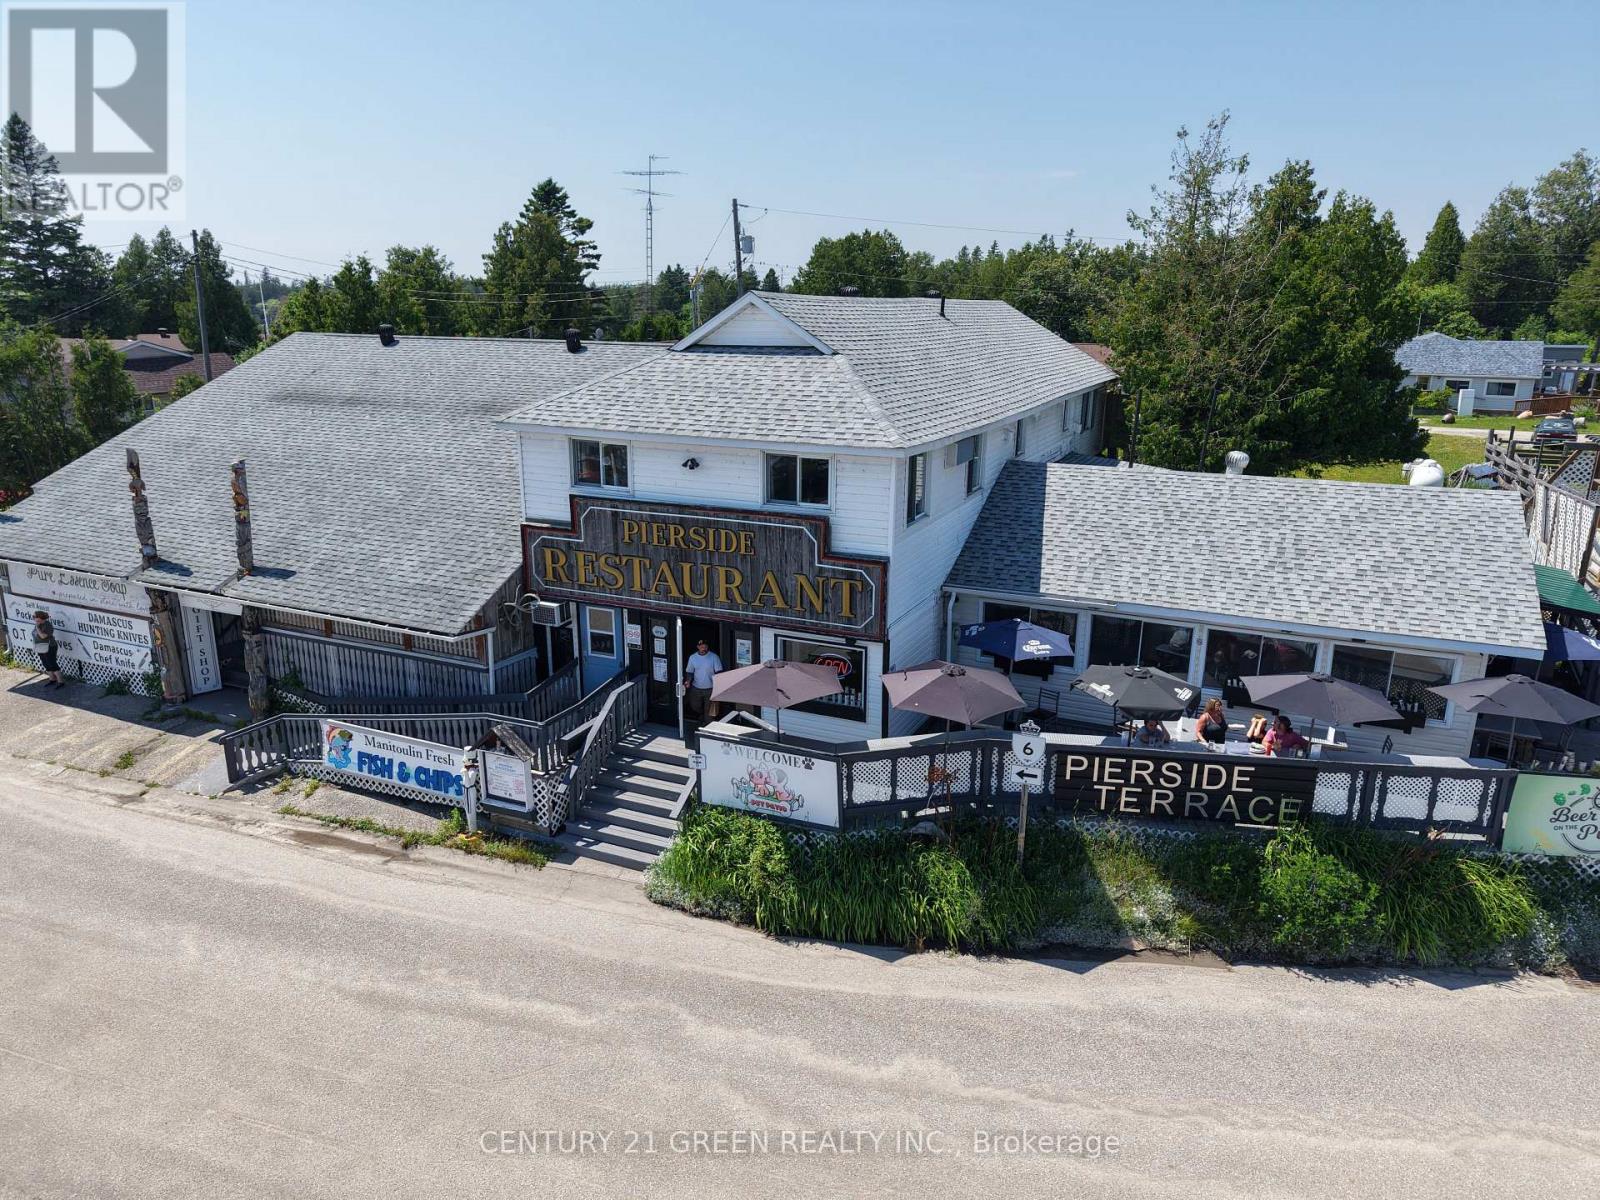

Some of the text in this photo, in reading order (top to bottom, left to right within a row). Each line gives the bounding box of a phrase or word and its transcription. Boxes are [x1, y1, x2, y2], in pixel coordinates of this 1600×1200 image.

[622, 519, 756, 556] PIERSIDE
[543, 547, 863, 618] RESTAURANT
[77, 622, 149, 645] HUNTING KNIVES
[88, 612, 133, 630] DAMASCUS
[93, 641, 132, 656] Damascus
[93, 653, 136, 669] Chef Knife
[199, 648, 210, 685] SHOP
[364, 735, 455, 767] Manitoulin Fresh
[735, 747, 800, 768] WELCOME
[1022, 742, 1034, 756] 6
[357, 751, 393, 780] FISH
[397, 761, 410, 783] &
[414, 765, 463, 797] CHIPS
[1065, 755, 1256, 793] PIERSIDE
[1093, 785, 1303, 824] TERRACE
[1549, 807, 1597, 823] Beer
